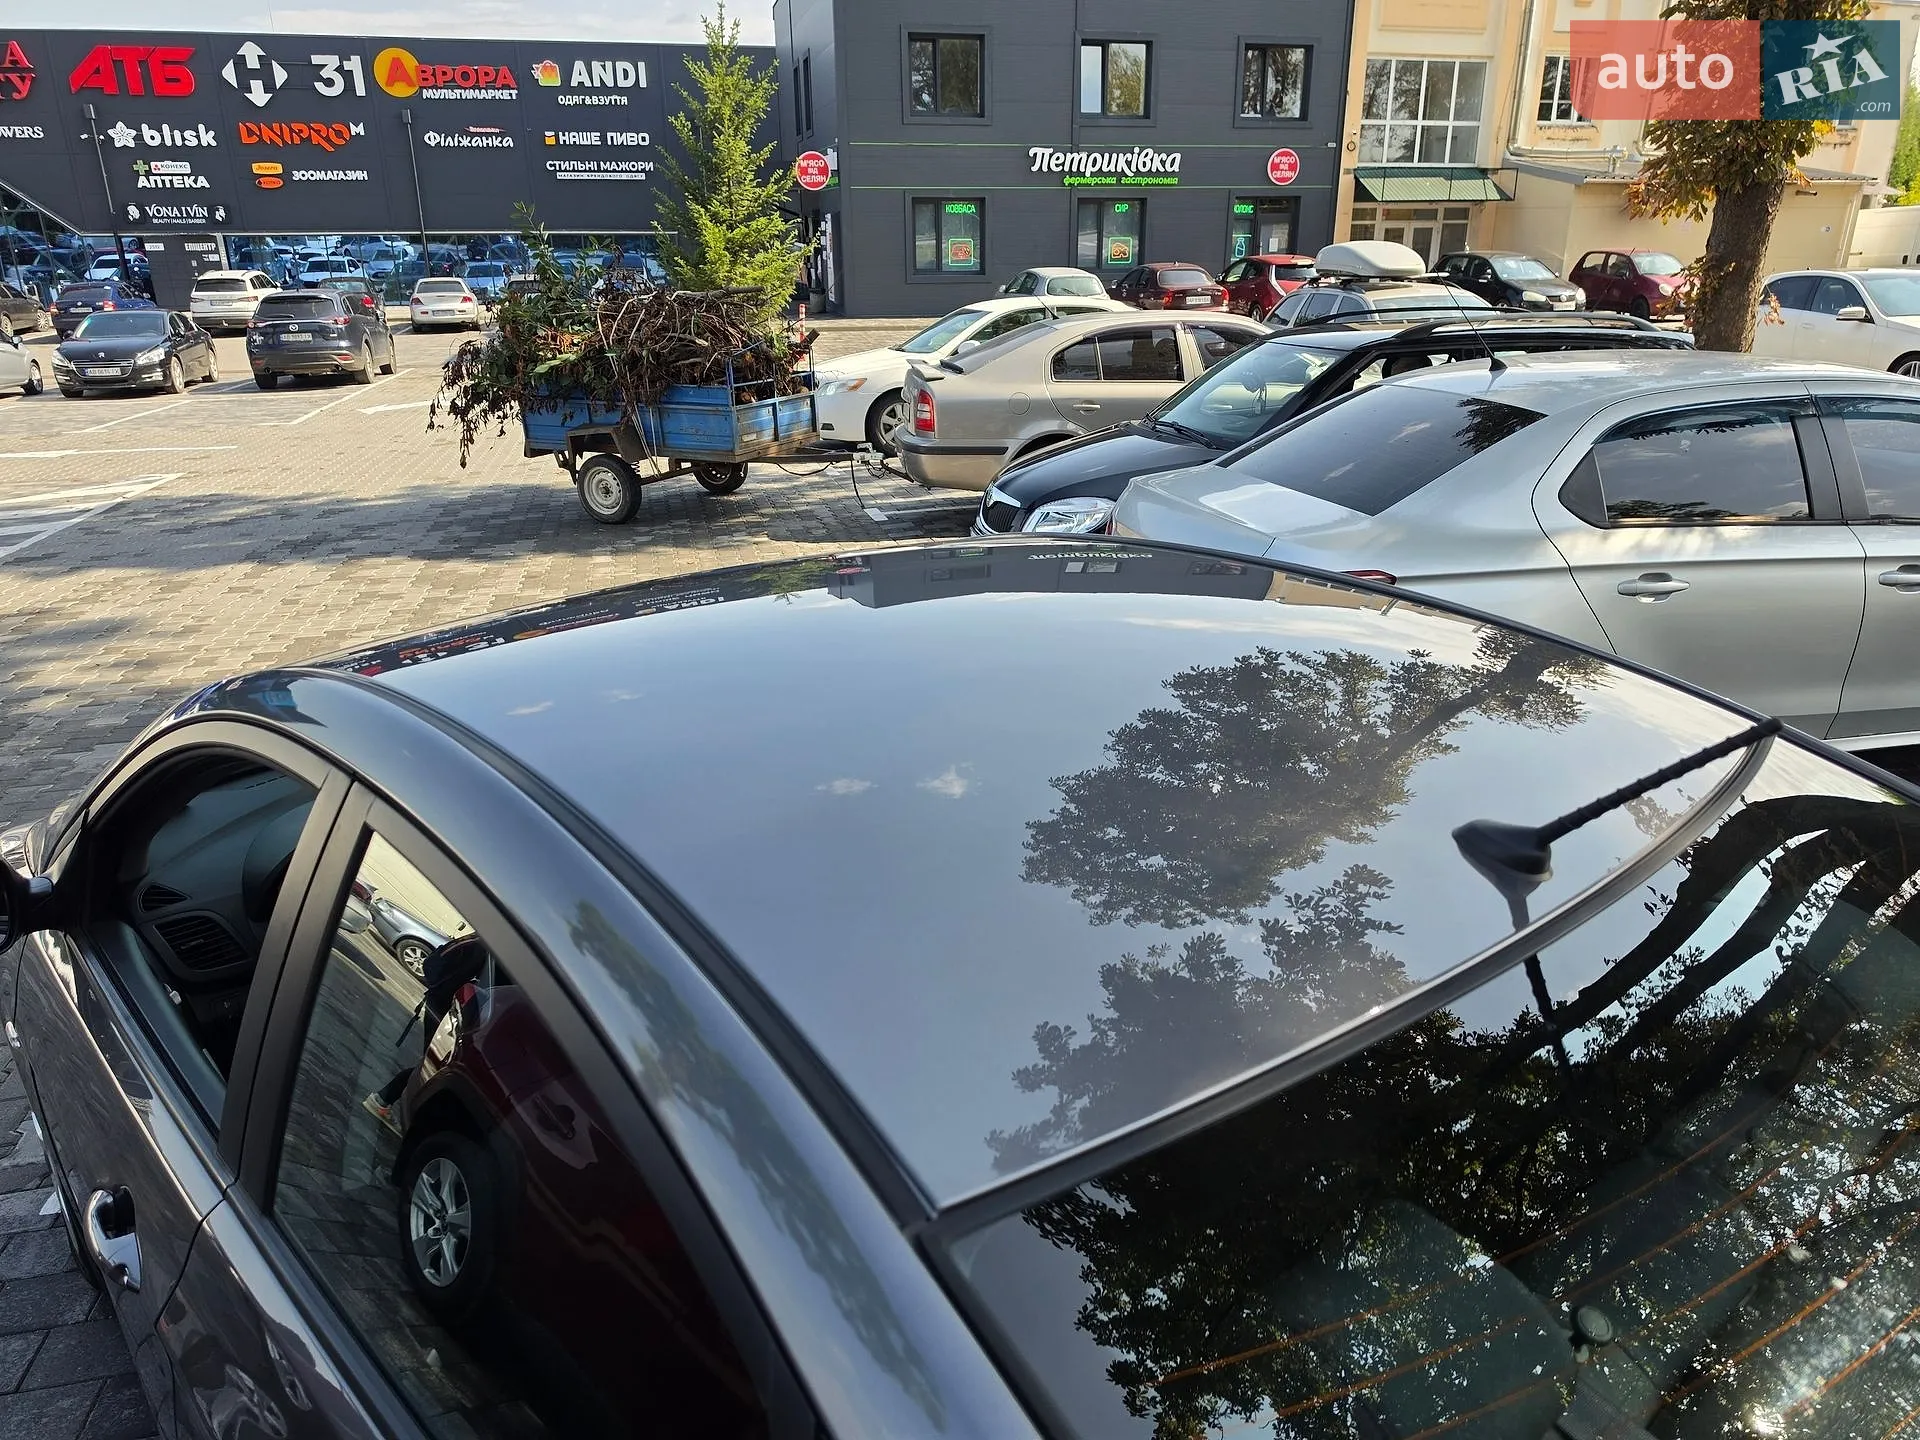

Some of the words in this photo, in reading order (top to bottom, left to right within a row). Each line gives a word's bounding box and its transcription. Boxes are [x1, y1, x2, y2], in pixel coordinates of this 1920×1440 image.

[69, 44, 197, 97] АТБ
[310, 54, 366, 97] 31
[385, 57, 518, 89] АВРОРА
[571, 60, 647, 88] ANDI
[422, 88, 518, 100] МУЛЬТИМАРКЕТ
[558, 95, 628, 106] ОДЯГ&ВЗУТТЯ
[142, 121, 218, 147] blisk
[424, 130, 514, 149] Філіжанка
[559, 131, 602, 145] НАШЕ
[606, 132, 650, 146] ПИВО
[546, 160, 598, 171] СТИЛЬНІ
[598, 161, 654, 172] МАЖОРИ
[1028, 146, 1182, 177] Петриківка
[138, 175, 211, 189] АПТЕКА
[292, 170, 369, 181] ЗООМАГАЗИН
[1063, 175, 1117, 187] фермерська
[1120, 176, 1179, 187] гастрономія
[145, 204, 181, 217] VONA
[945, 204, 976, 213] КОВБАСА
[1114, 204, 1129, 212] СИР
